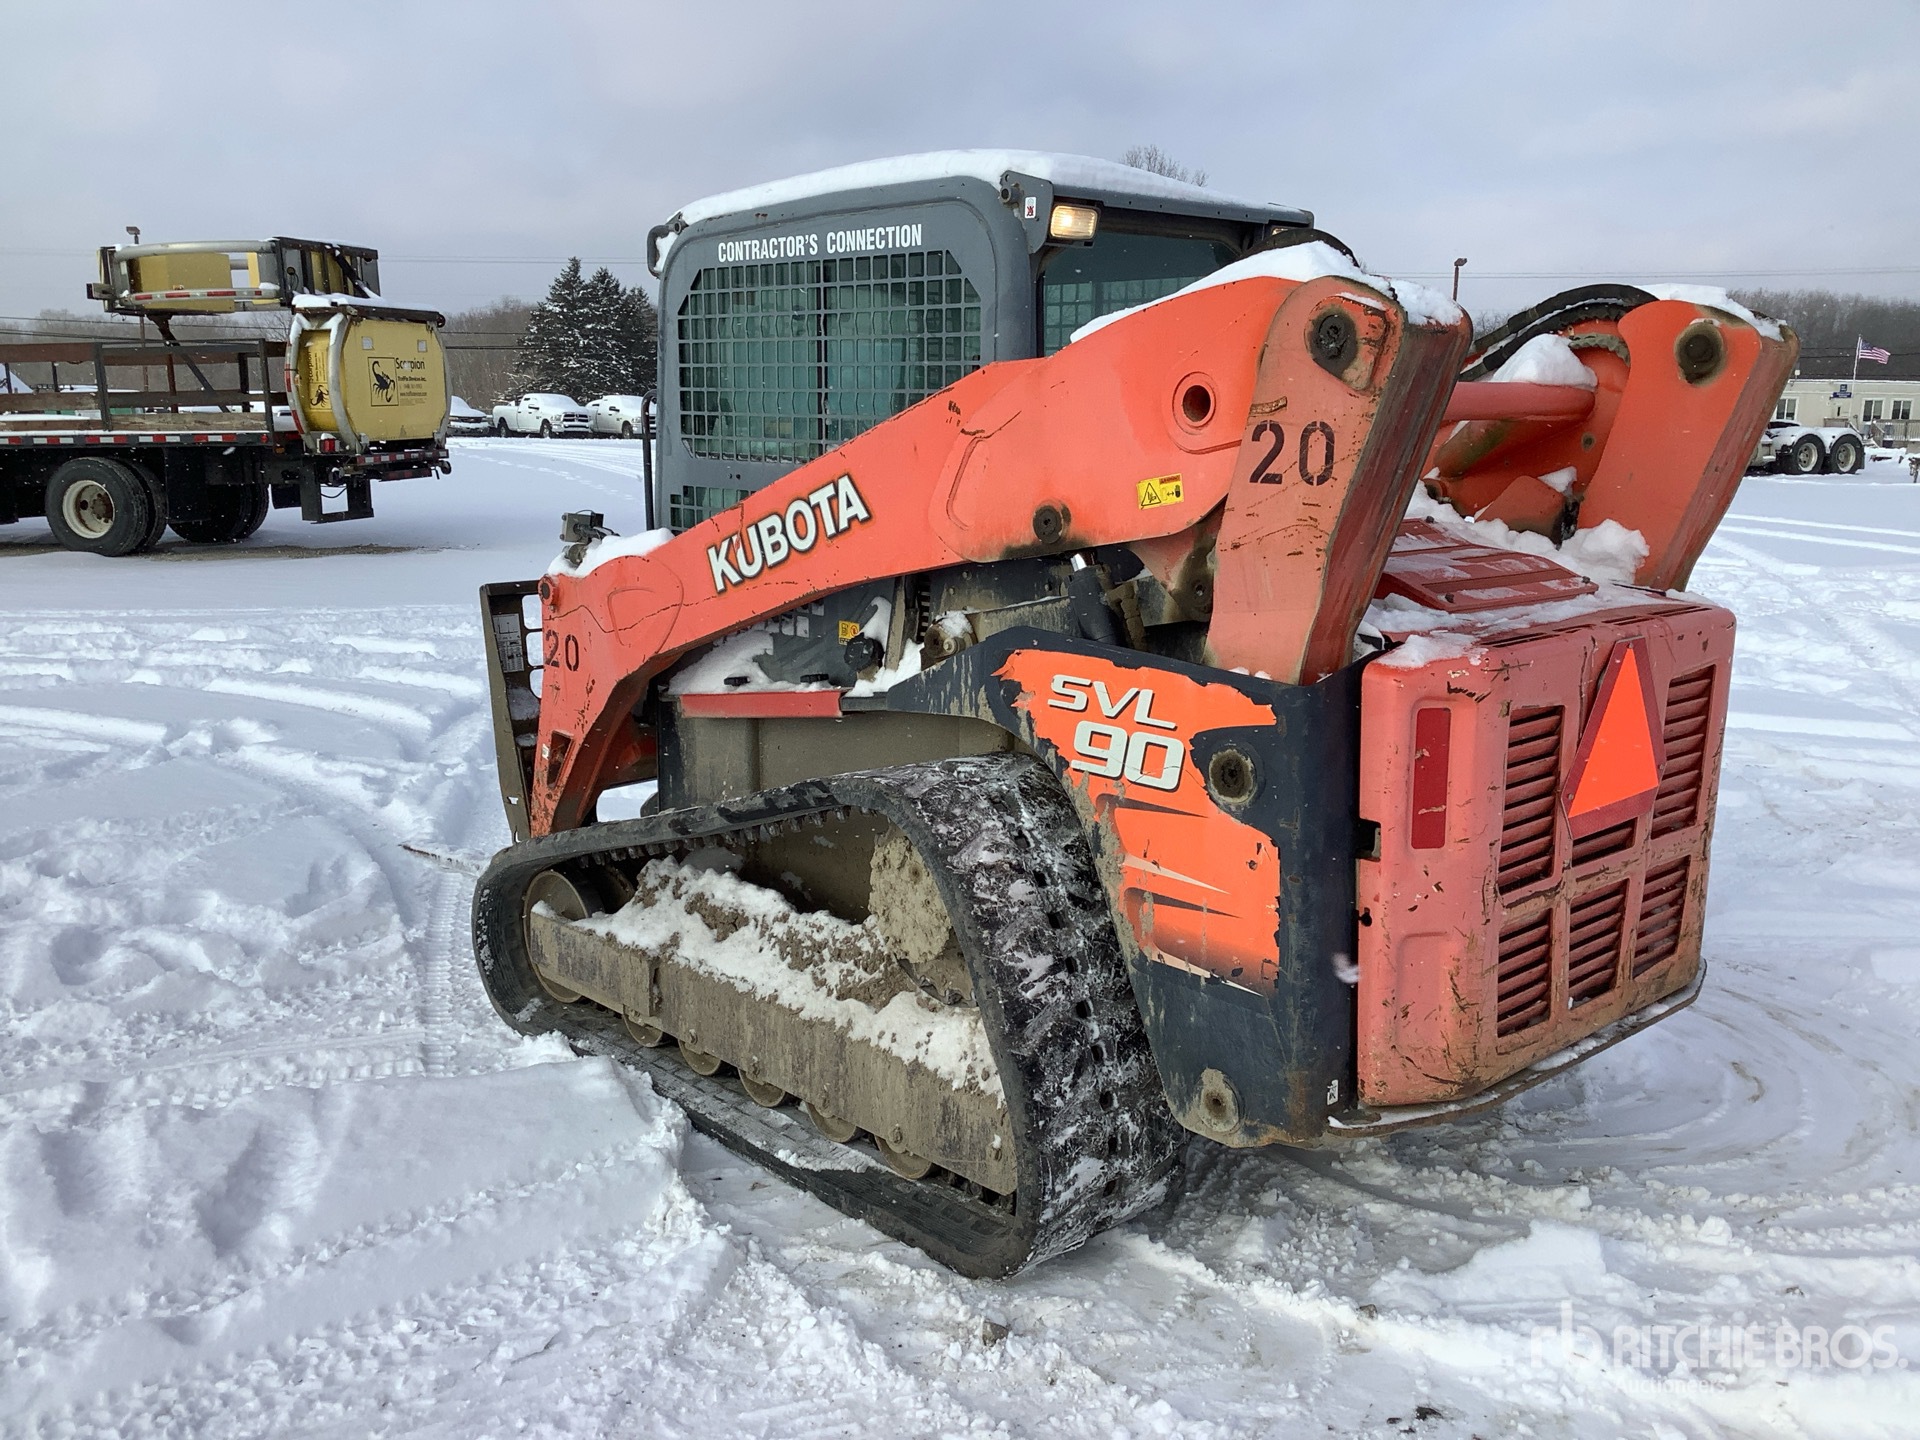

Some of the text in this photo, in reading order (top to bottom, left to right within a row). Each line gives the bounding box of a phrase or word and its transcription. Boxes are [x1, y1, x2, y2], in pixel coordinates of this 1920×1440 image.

[718, 223, 923, 263] CONTRACTOR'S CONNECTION
[1249, 419, 1336, 487] 20
[706, 473, 872, 594] KUBOTA
[544, 629, 580, 672] 20
[1047, 674, 1178, 730] SVL
[1069, 720, 1186, 793] 90
